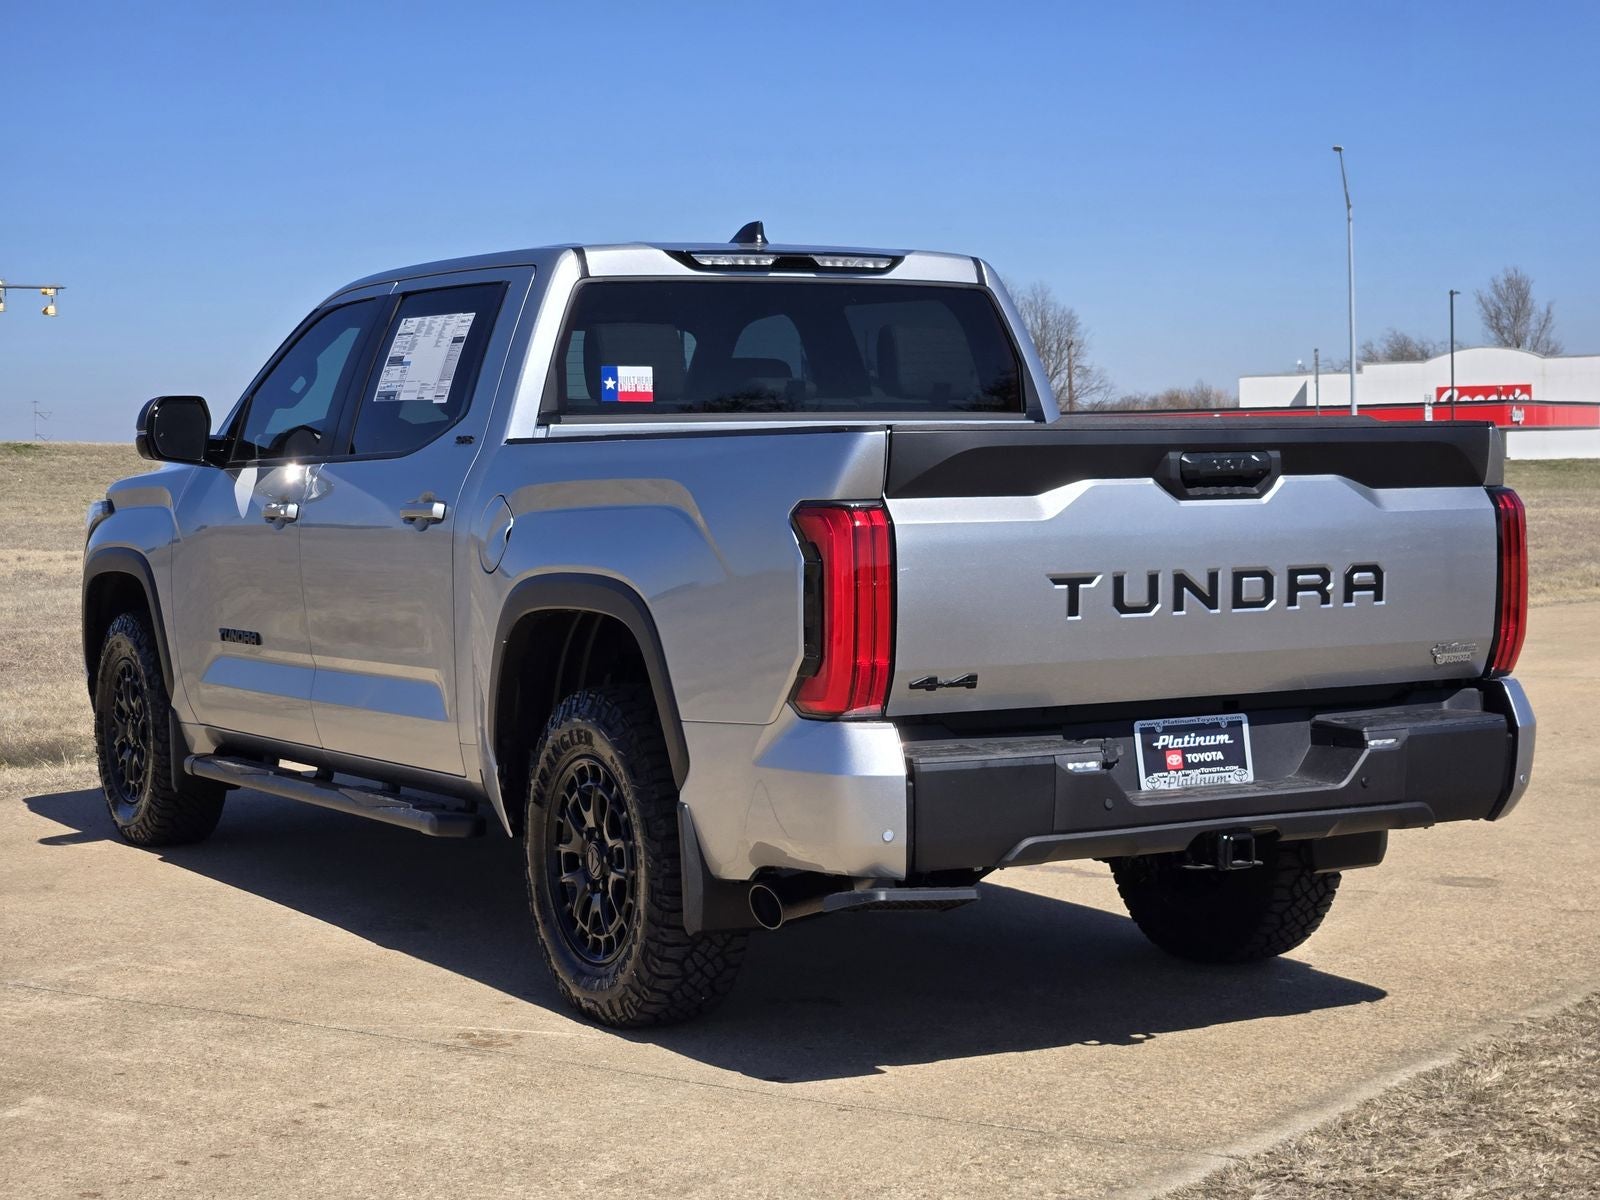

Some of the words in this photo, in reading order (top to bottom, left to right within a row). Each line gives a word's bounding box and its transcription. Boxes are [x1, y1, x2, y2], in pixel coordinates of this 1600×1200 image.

[637, 383, 653, 392] HERE
[1046, 561, 1386, 621] TUNDRA
[218, 627, 262, 646] TUNDRA
[1139, 714, 1243, 728] www.PlatinumToyota.com
[1152, 732, 1234, 750] Platinum
[1185, 751, 1225, 763] TOYOTA
[1168, 773, 1231, 788] Platinum
